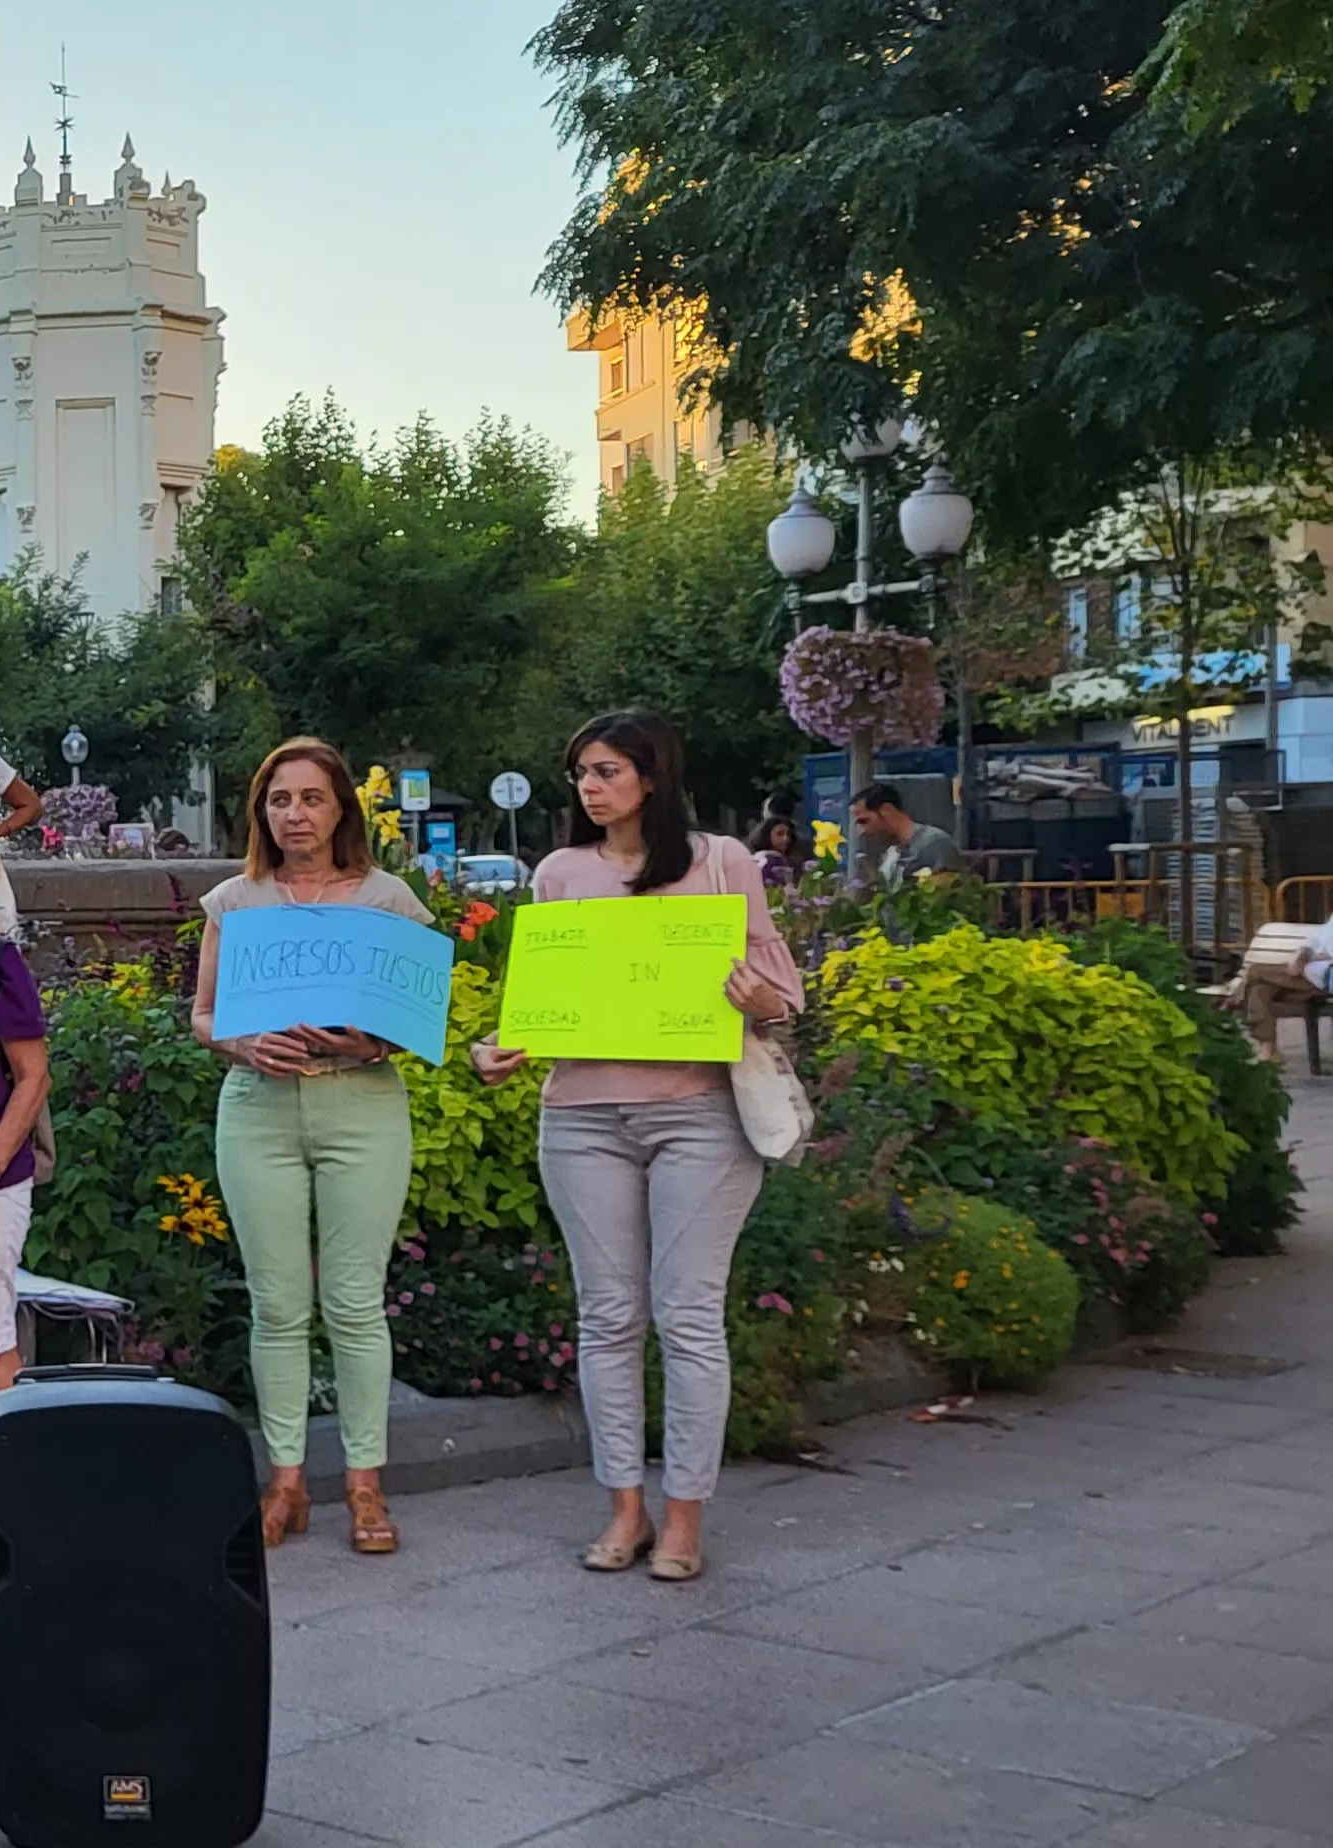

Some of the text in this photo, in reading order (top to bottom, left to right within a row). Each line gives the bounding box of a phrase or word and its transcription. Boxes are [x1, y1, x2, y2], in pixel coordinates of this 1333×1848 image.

[231, 939, 448, 1006] INGRESOS JUSTOS
[629, 962, 661, 983] IN
[508, 1010, 581, 1026] SOCIEDAD
